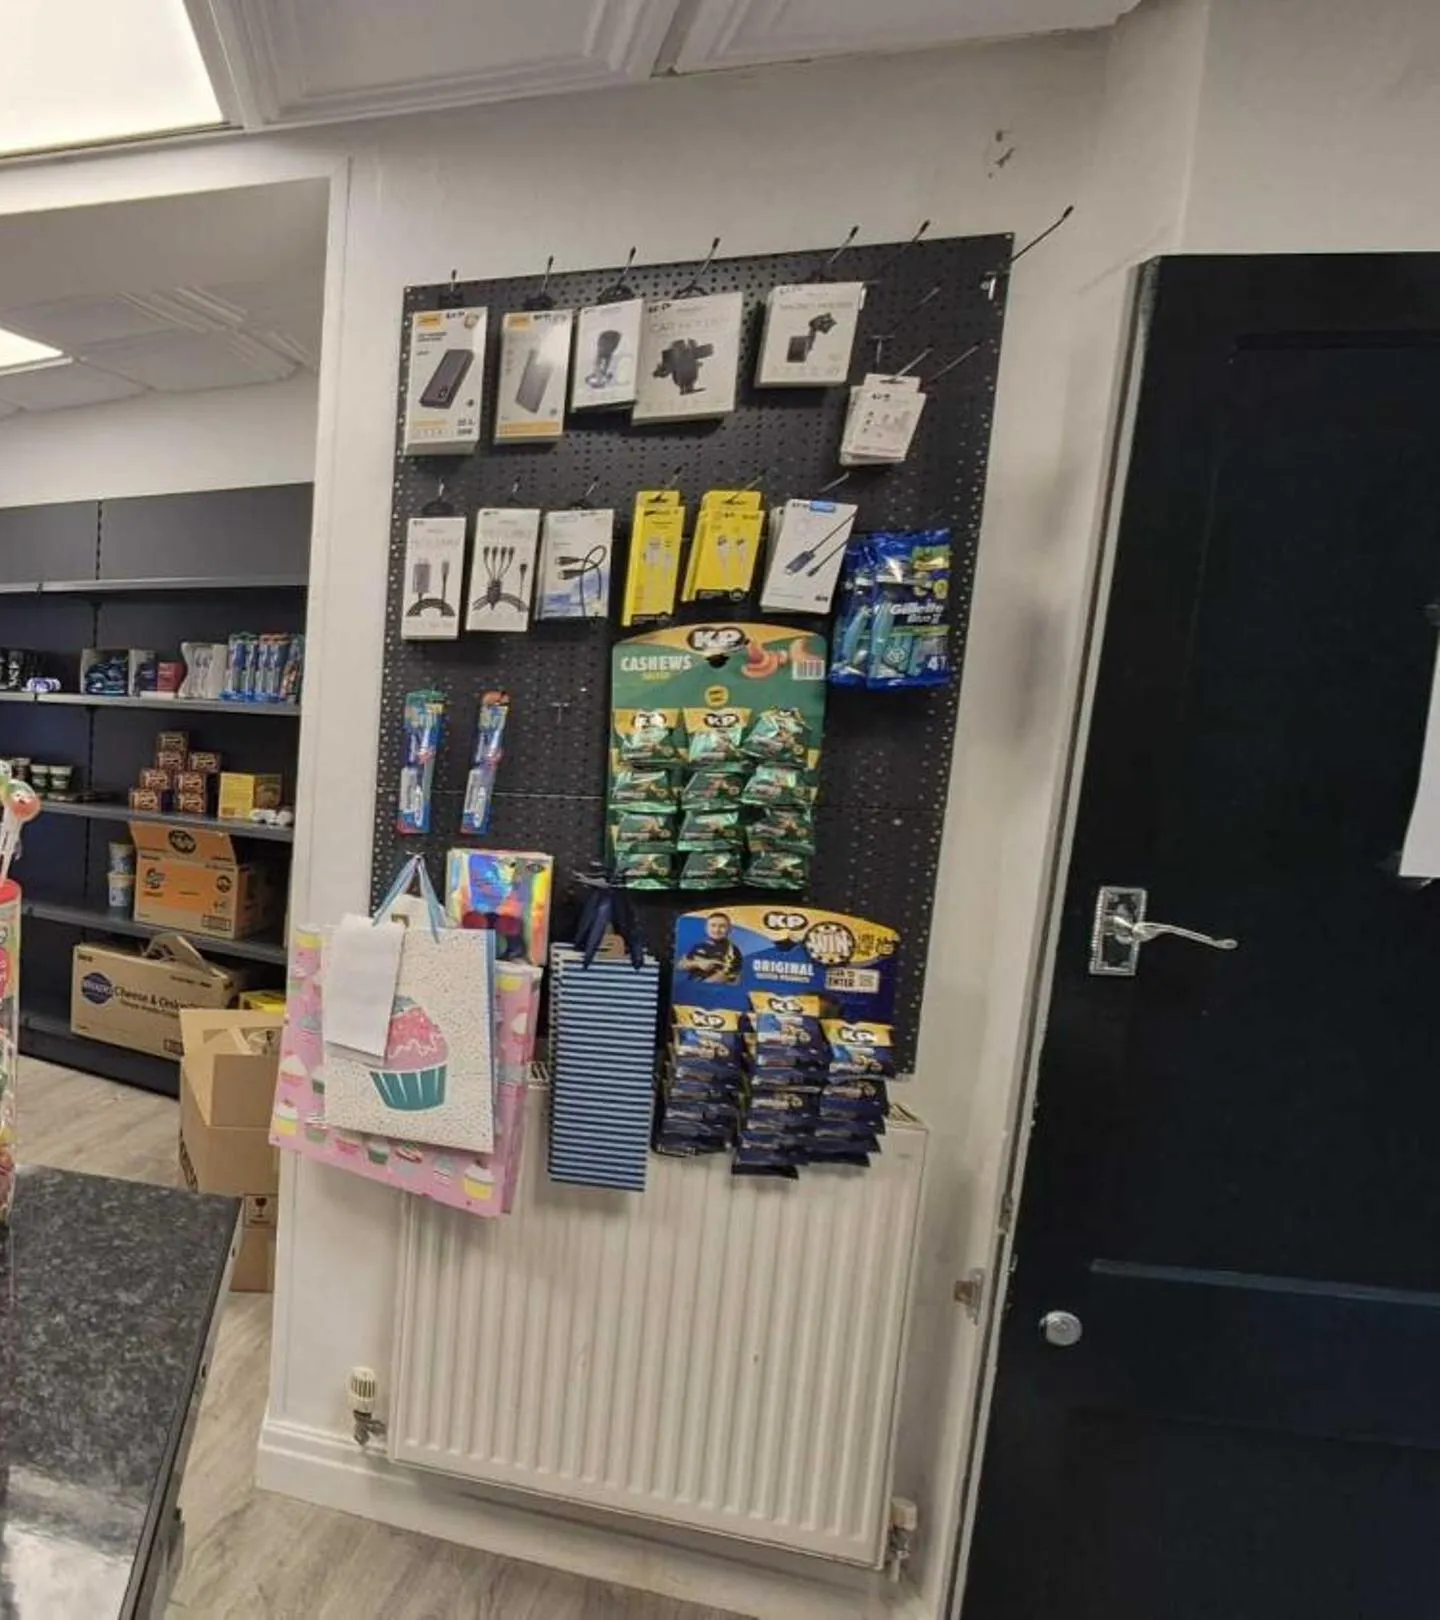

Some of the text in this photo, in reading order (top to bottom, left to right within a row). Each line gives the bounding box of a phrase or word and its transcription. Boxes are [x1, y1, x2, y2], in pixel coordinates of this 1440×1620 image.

[890, 600, 944, 615] Gillette
[692, 629, 742, 650] KP
[621, 655, 693, 672] CASHEWS
[767, 913, 806, 929] KP
[753, 959, 815, 977] ORIGINAL
